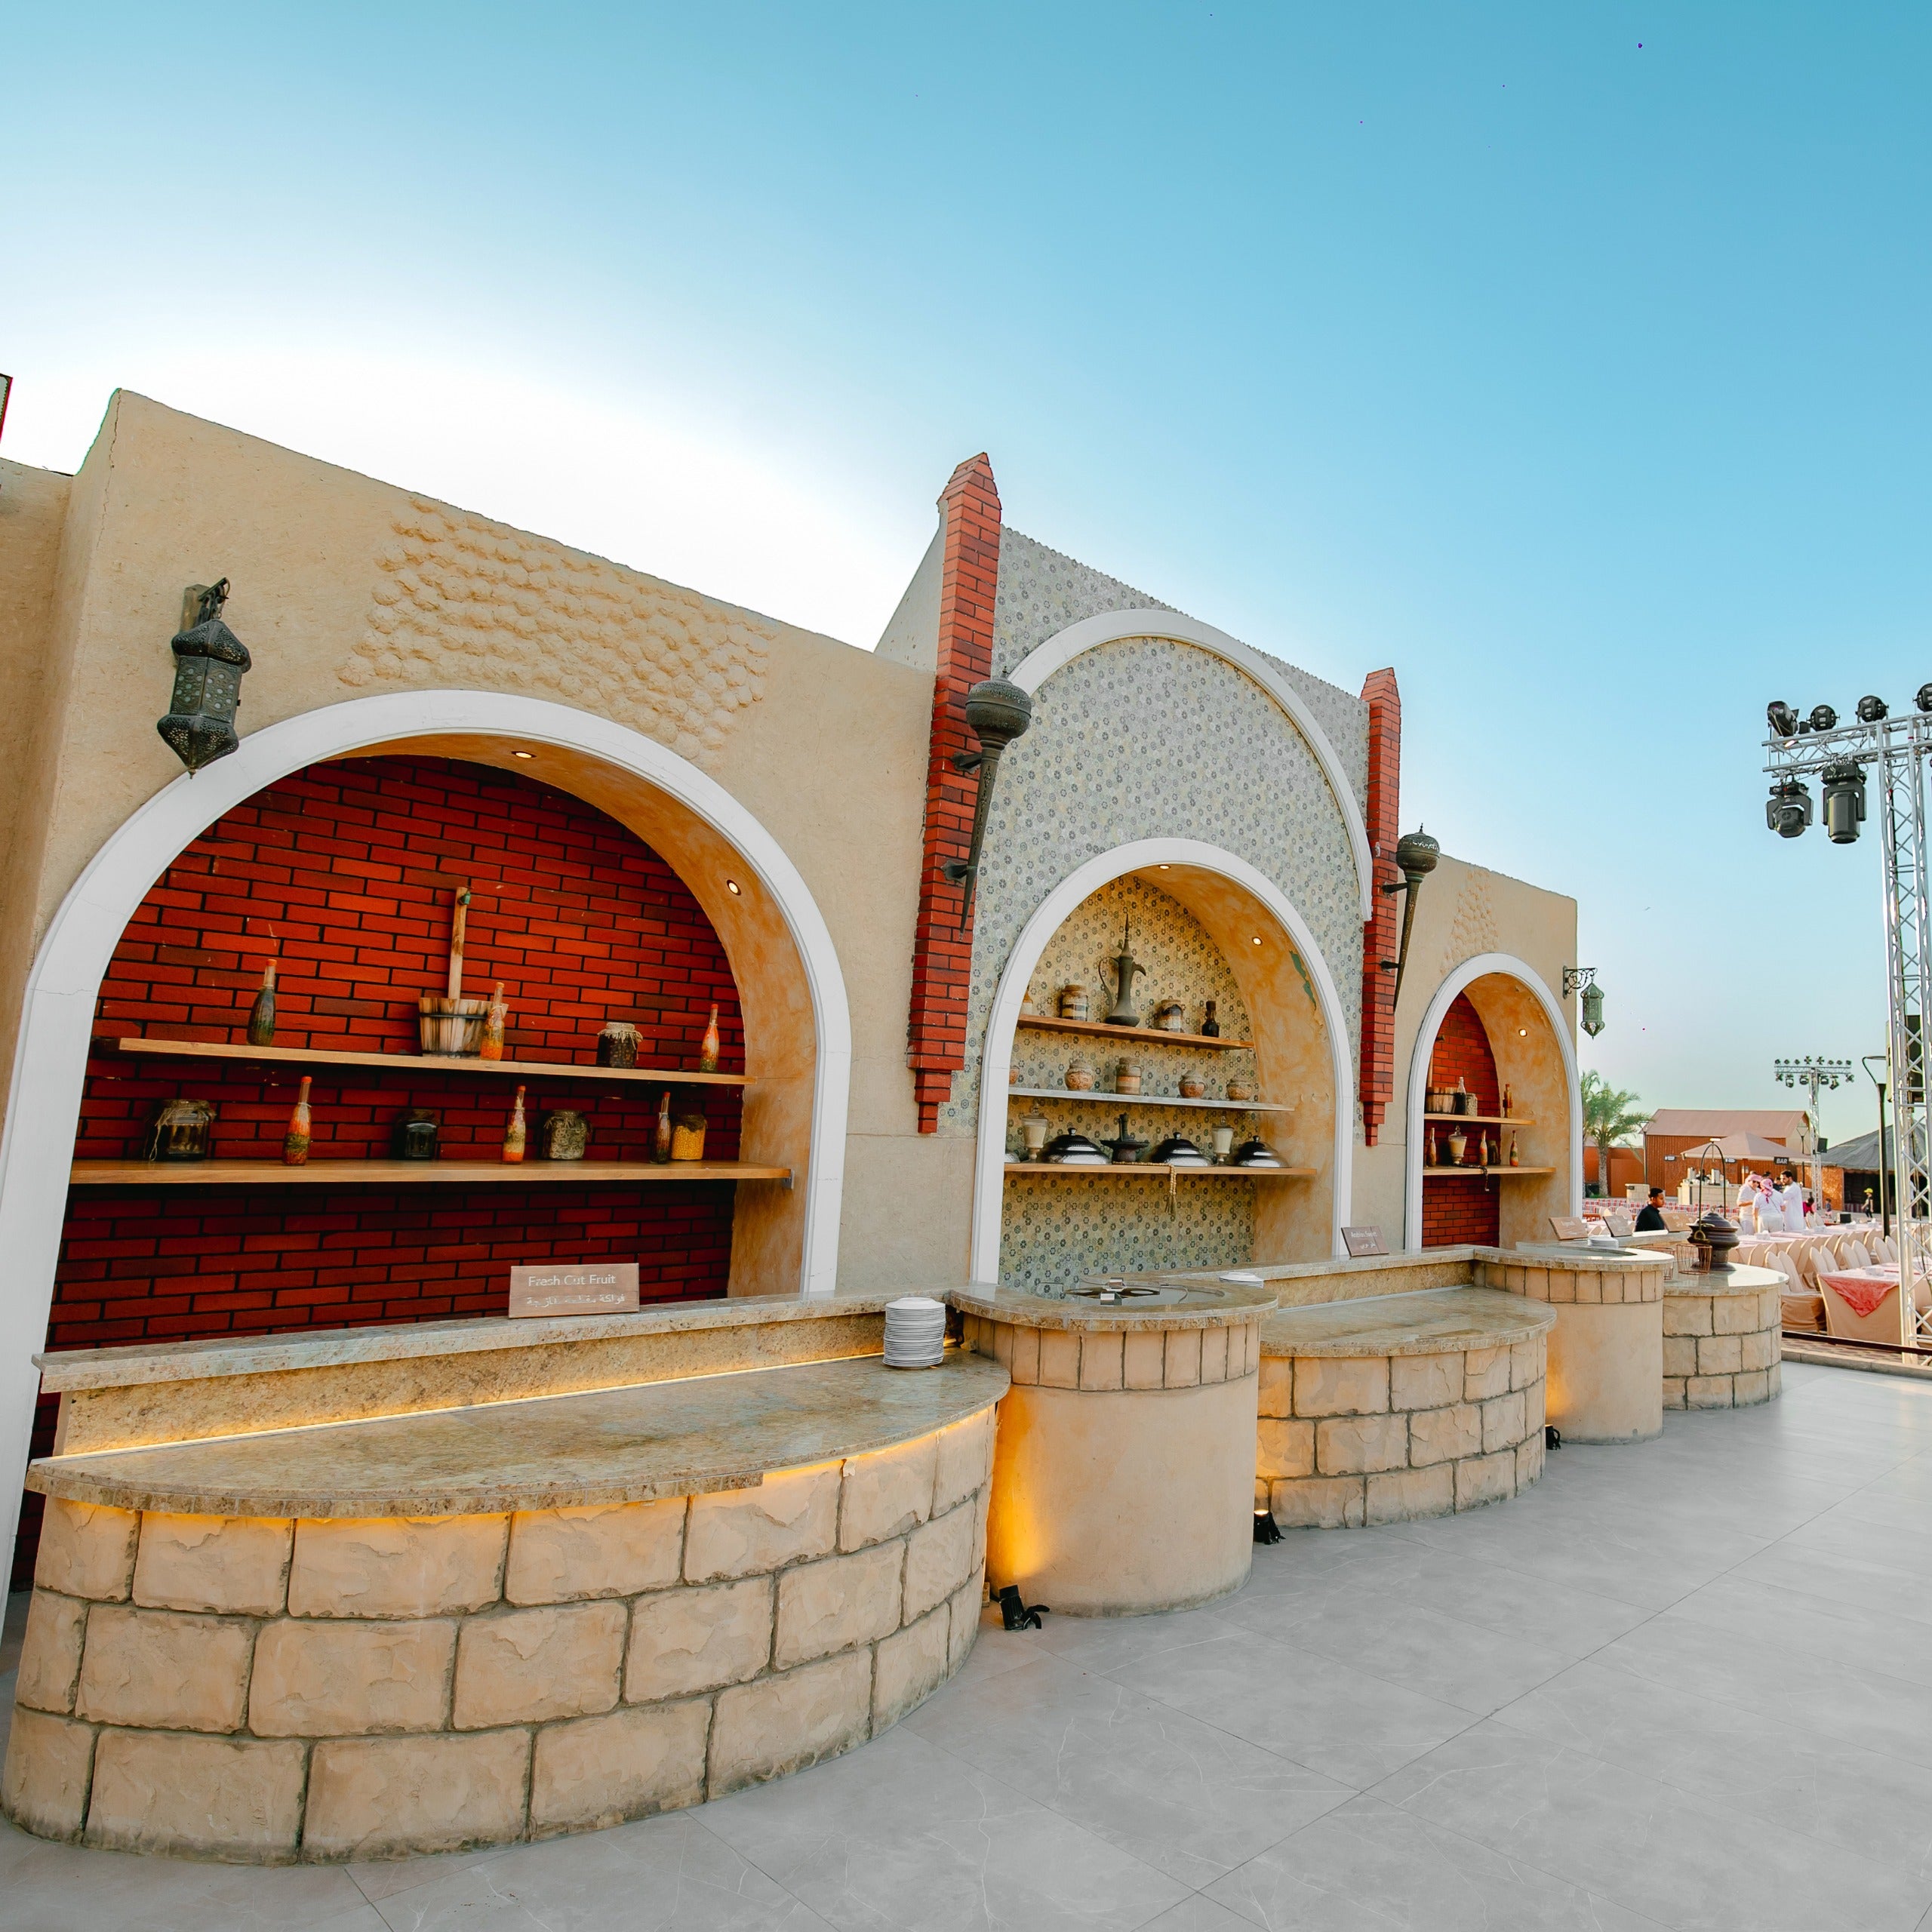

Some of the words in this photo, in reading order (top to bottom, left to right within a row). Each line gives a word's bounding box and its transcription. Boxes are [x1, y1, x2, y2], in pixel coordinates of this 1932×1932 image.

[528, 1275, 560, 1287] Fresh
[564, 1275, 586, 1285] Cut
[589, 1274, 616, 1284] Fruit
